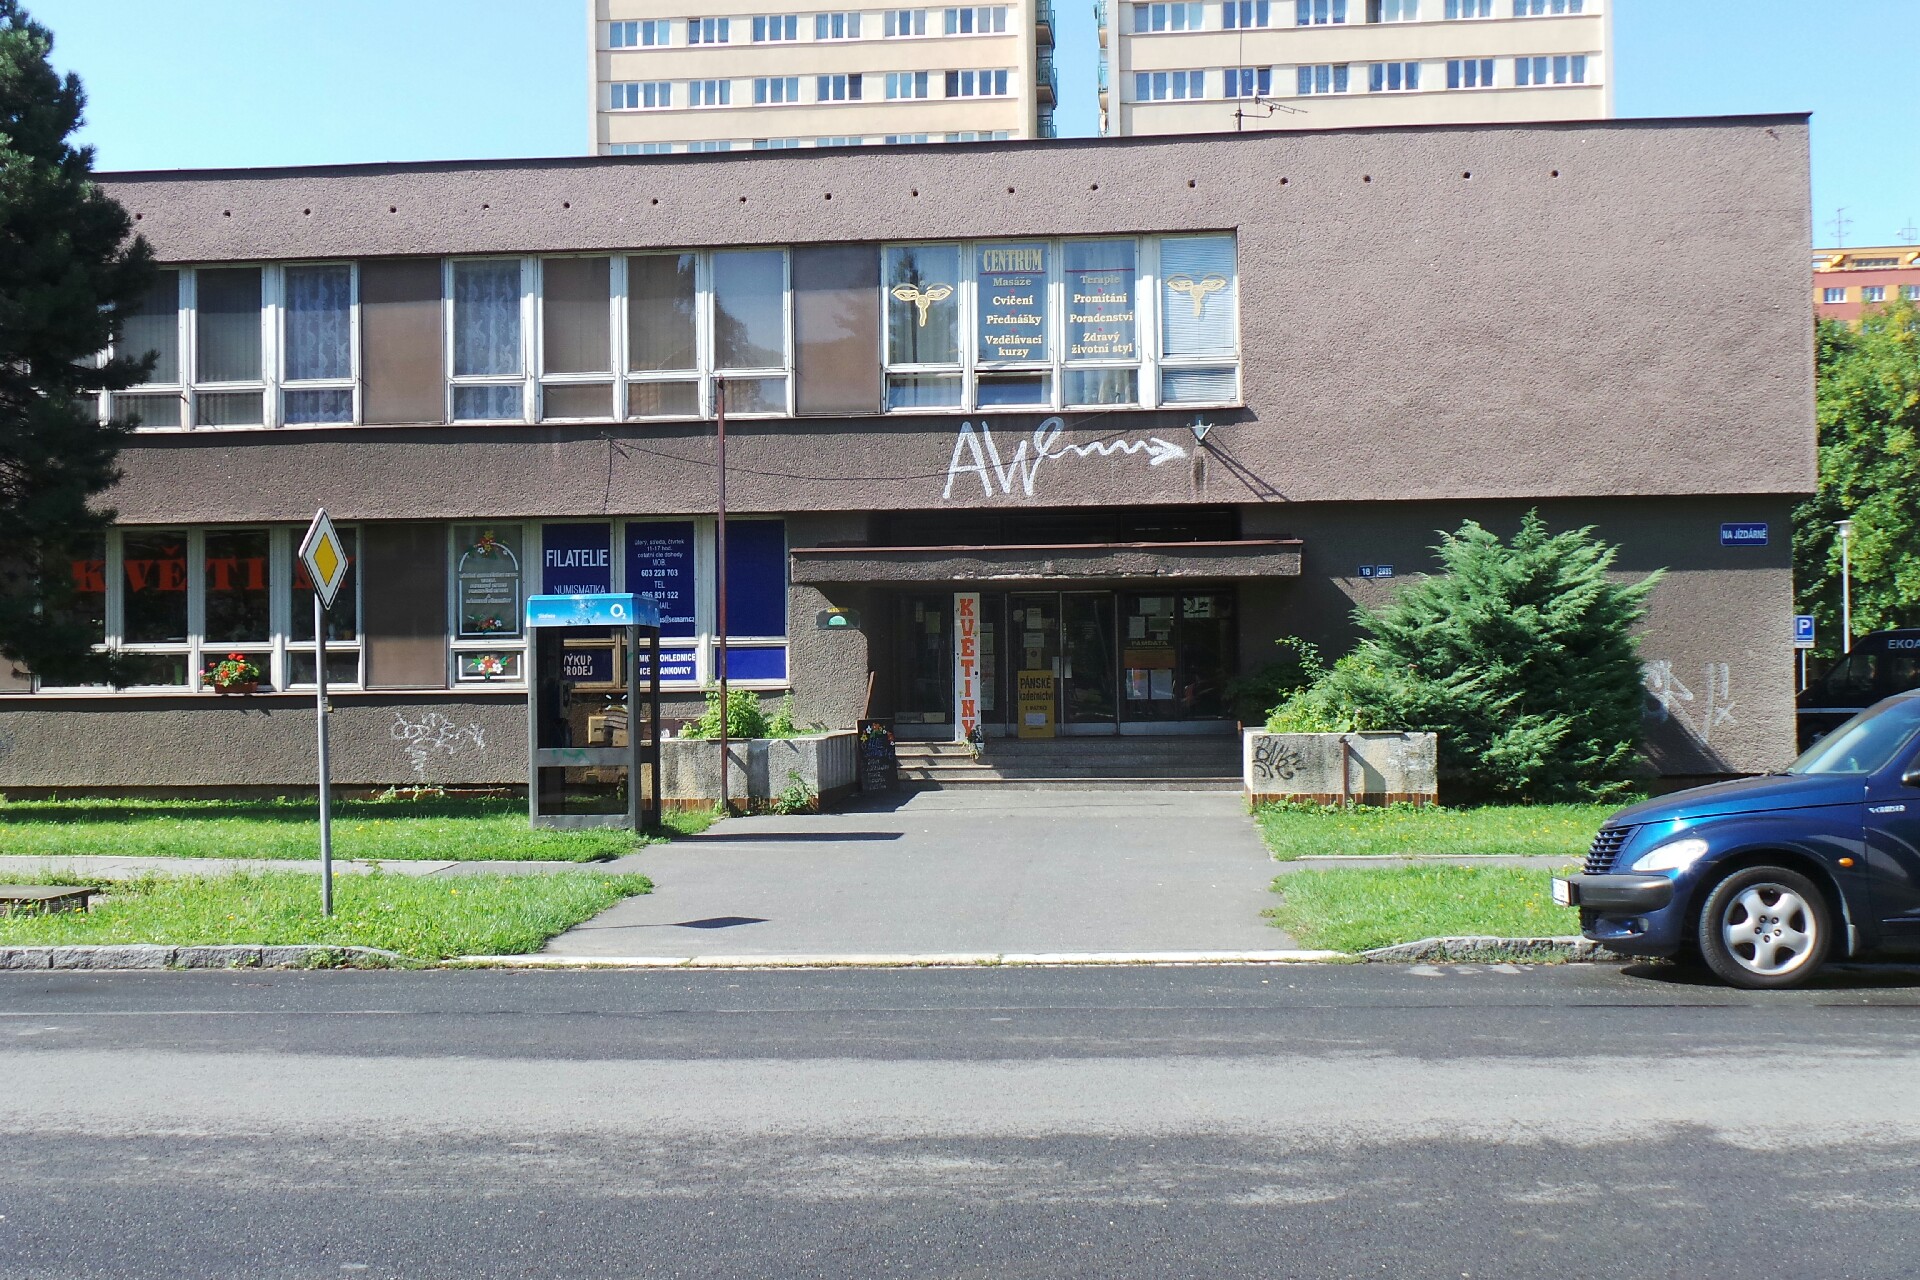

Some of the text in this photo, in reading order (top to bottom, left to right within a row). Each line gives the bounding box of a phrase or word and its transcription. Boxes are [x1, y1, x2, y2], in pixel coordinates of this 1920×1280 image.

[983, 248, 1043, 272] CENTRUM
[992, 275, 1032, 287] Masáže
[1080, 274, 1121, 285] Terapie
[992, 295, 1033, 306] Cvičení
[1073, 292, 1128, 304] Promítání
[986, 314, 1042, 326] Přednášky
[1069, 312, 1134, 323] Poradenství
[984, 333, 1042, 345] Vzdělávací
[1082, 332, 1120, 344] Zdravý
[998, 346, 1029, 358] kurzy
[1071, 343, 1134, 354] životní styl
[1723, 530, 1733, 539] NA
[546, 549, 609, 567] FILATELIE
[641, 569, 679, 577] 603 228 703
[1362, 568, 1371, 576] 18
[553, 584, 606, 594] NUMISMATIKA
[654, 591, 665, 599] 831
[667, 591, 679, 599] 922
[660, 652, 696, 662] OHLEDNICE
[660, 666, 691, 675] ANKOVKY
[1020, 675, 1051, 689] PÁNSKÉ
